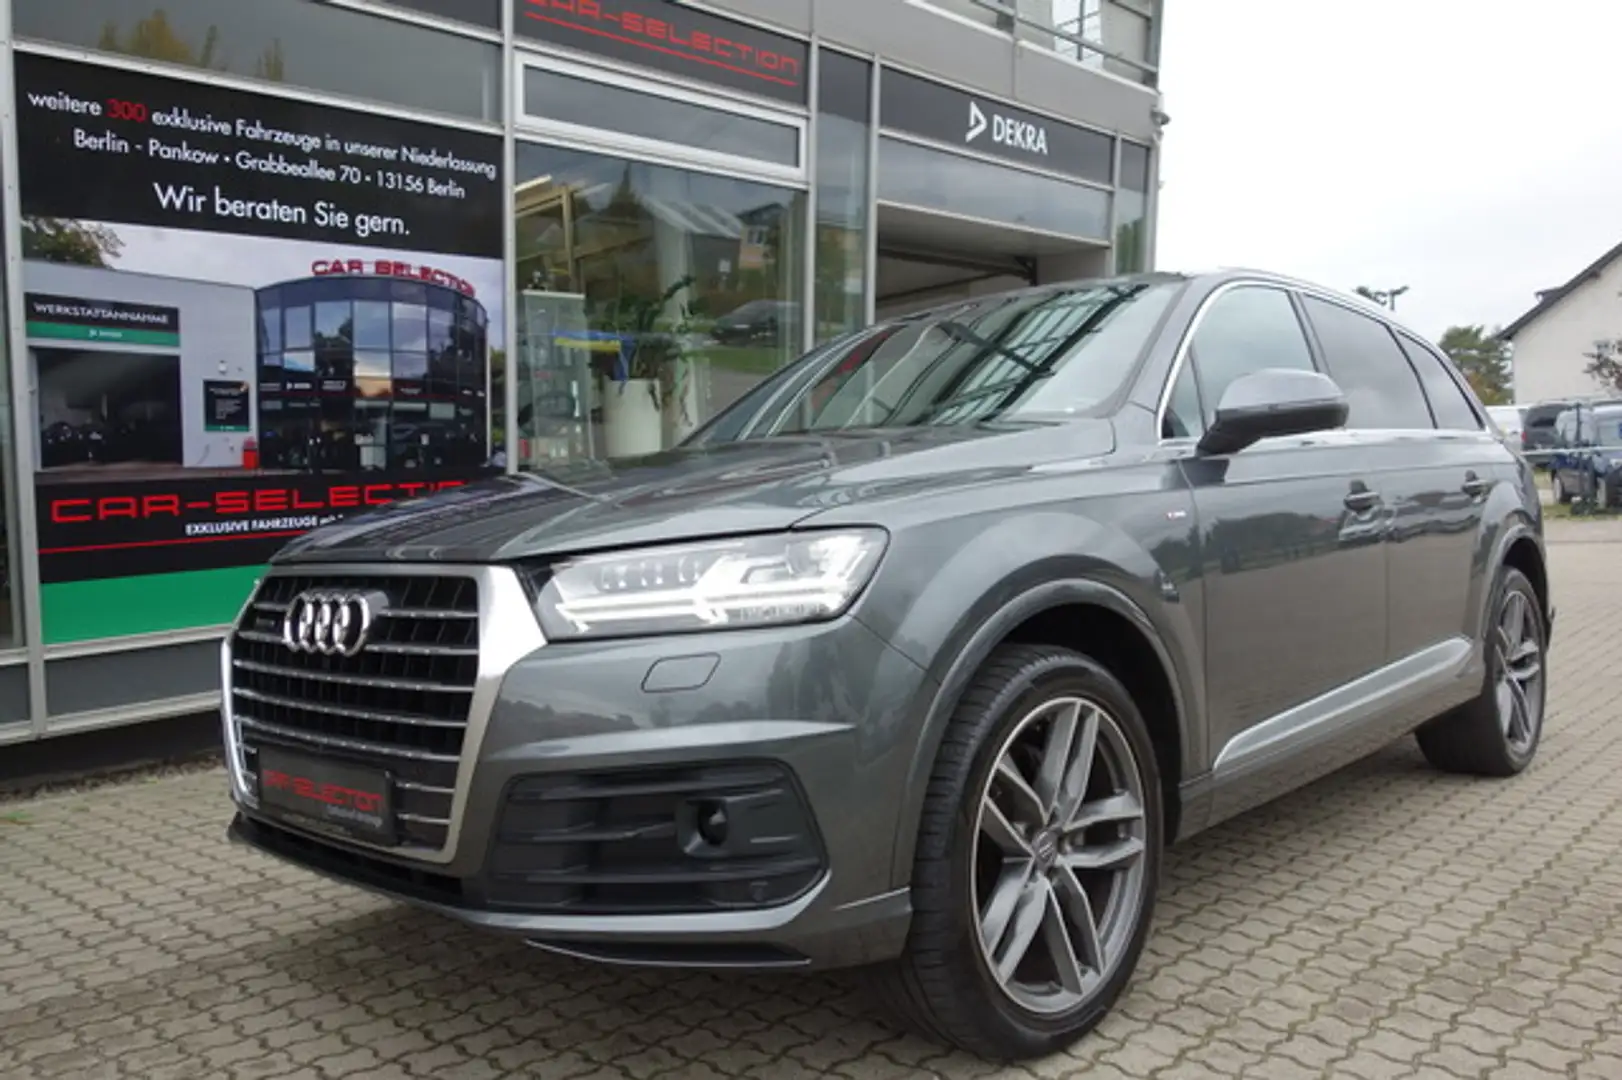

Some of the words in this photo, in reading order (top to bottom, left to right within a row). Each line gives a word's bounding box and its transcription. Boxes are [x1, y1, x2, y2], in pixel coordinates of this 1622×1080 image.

[28, 92, 102, 116] weitere
[106, 98, 147, 122] 300
[151, 107, 232, 135] exklusive
[235, 119, 322, 152] Fahrzeuge
[325, 133, 341, 151] in
[344, 142, 399, 160] unserer
[401, 146, 497, 179] Niederlassung
[992, 113, 1048, 155] DEKRA
[74, 128, 129, 153] Berlin
[149, 138, 219, 164] Pankow
[235, 150, 336, 181] Grabbeallee
[340, 165, 361, 184] 70
[377, 170, 424, 192] 13156
[427, 180, 465, 199] Berlin
[153, 182, 207, 213] Wir
[214, 186, 306, 224] beraten
[314, 201, 349, 229] Sie
[354, 213, 411, 238] gern.
[311, 259, 364, 276] CAR
[185, 518, 250, 536] EXKLUSIVE
[251, 515, 318, 531] FAHRZEUGE
